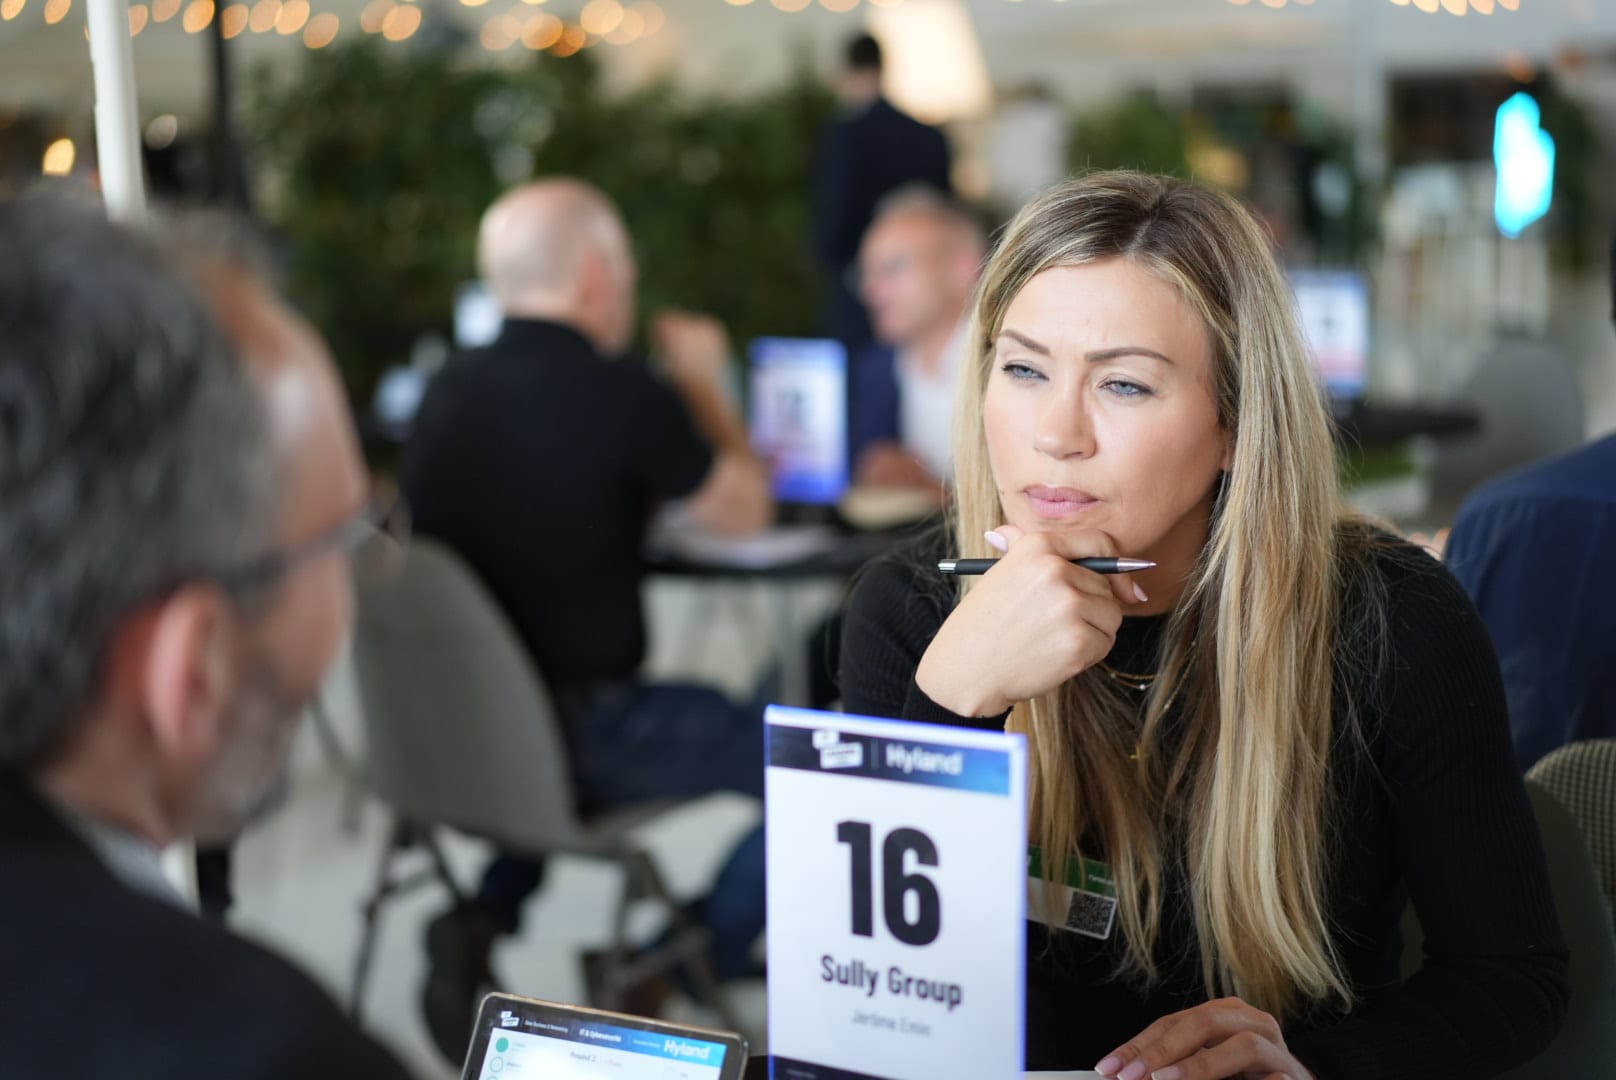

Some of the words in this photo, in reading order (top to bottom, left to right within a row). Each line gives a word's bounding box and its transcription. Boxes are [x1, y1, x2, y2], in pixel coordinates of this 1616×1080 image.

[886, 743, 963, 776] Hyland
[836, 820, 941, 946] 16
[821, 954, 878, 997] Sully
[888, 966, 962, 1012] Group
[663, 1039, 711, 1060] Hyland
